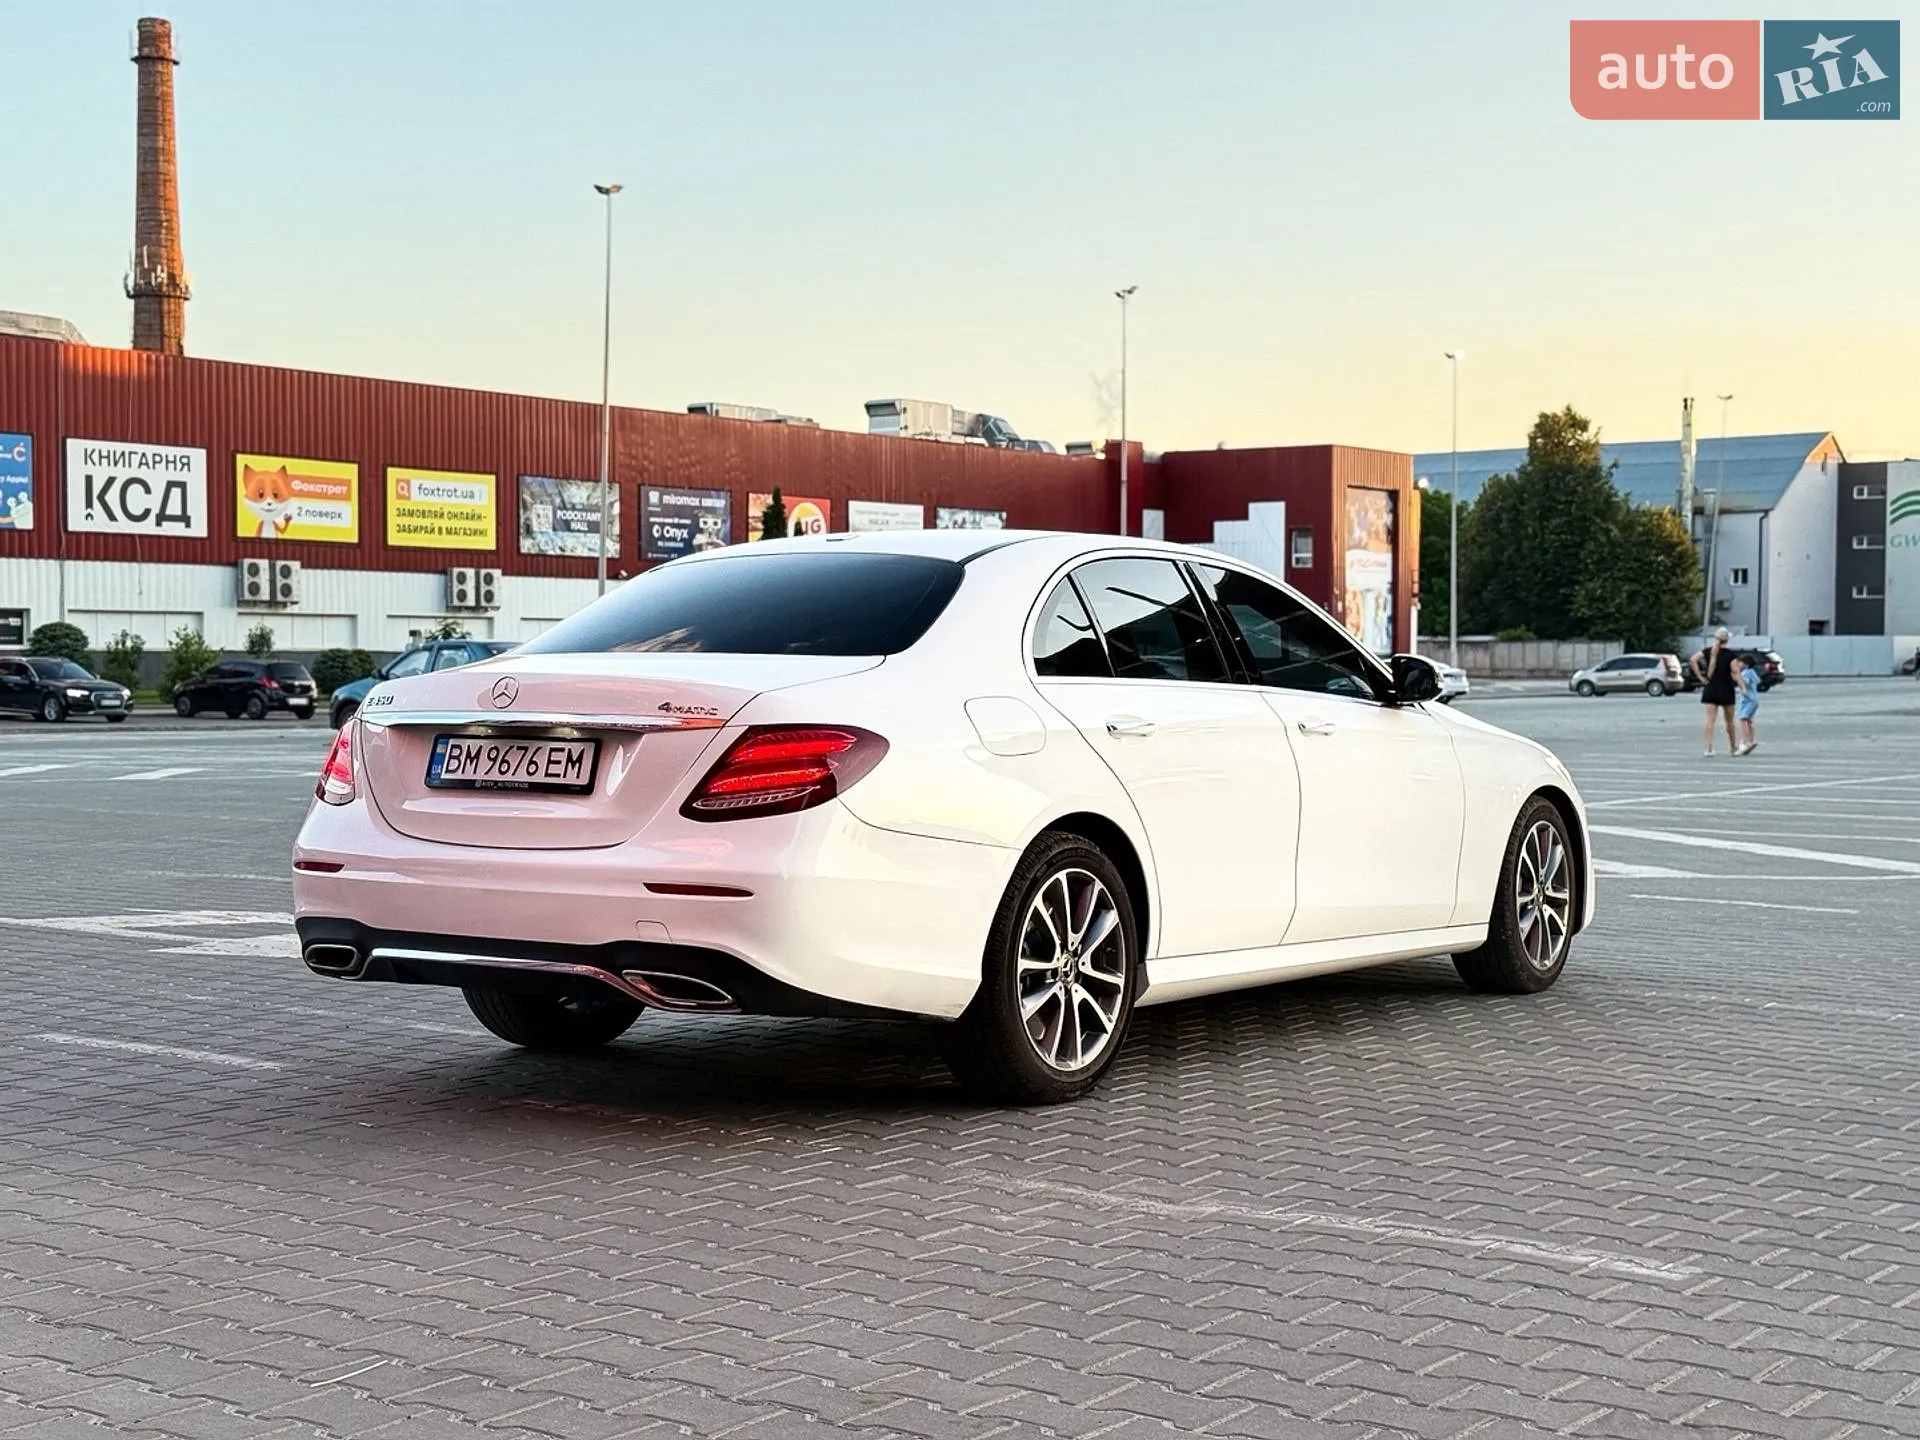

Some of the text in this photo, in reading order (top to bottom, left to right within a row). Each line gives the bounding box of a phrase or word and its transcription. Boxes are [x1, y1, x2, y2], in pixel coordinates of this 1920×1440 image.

[84, 447, 192, 473] КНИГАРНЯ
[291, 479, 348, 496] Фокстрот
[417, 483, 476, 500] foxtrot.ua
[84, 474, 192, 529] КСД
[296, 505, 343, 521] 2 поверх
[396, 507, 445, 521] ЗАМОВЛЯЙ
[396, 522, 436, 536] ЗАБИРАЙ
[437, 526, 444, 536] В
[444, 743, 586, 780] BM 9676 EM
